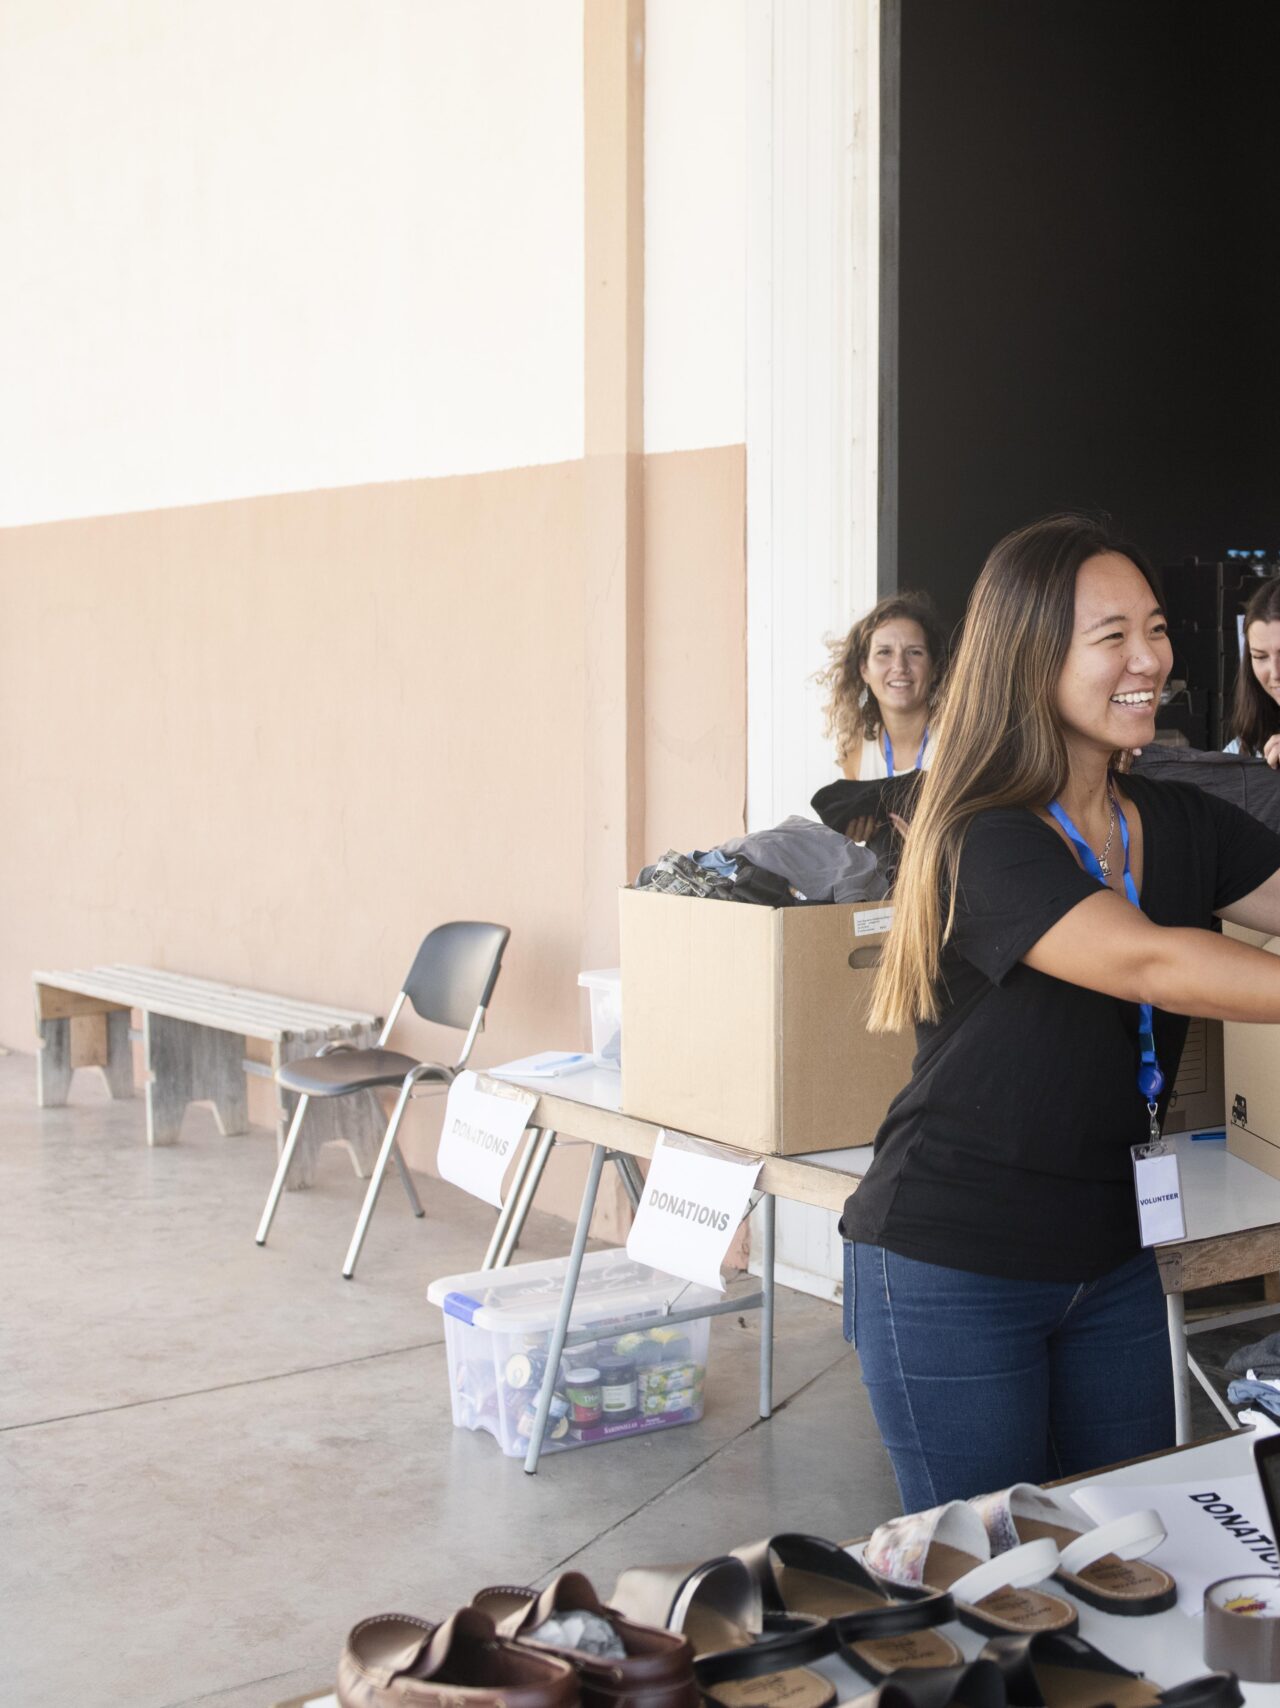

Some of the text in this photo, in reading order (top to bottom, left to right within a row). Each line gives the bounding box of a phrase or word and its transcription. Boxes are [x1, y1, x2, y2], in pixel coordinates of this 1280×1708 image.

[452, 1118, 509, 1156] DONATIONS
[648, 1189, 730, 1232] DONATIONS
[1140, 1192, 1179, 1206] VOLUNTEER
